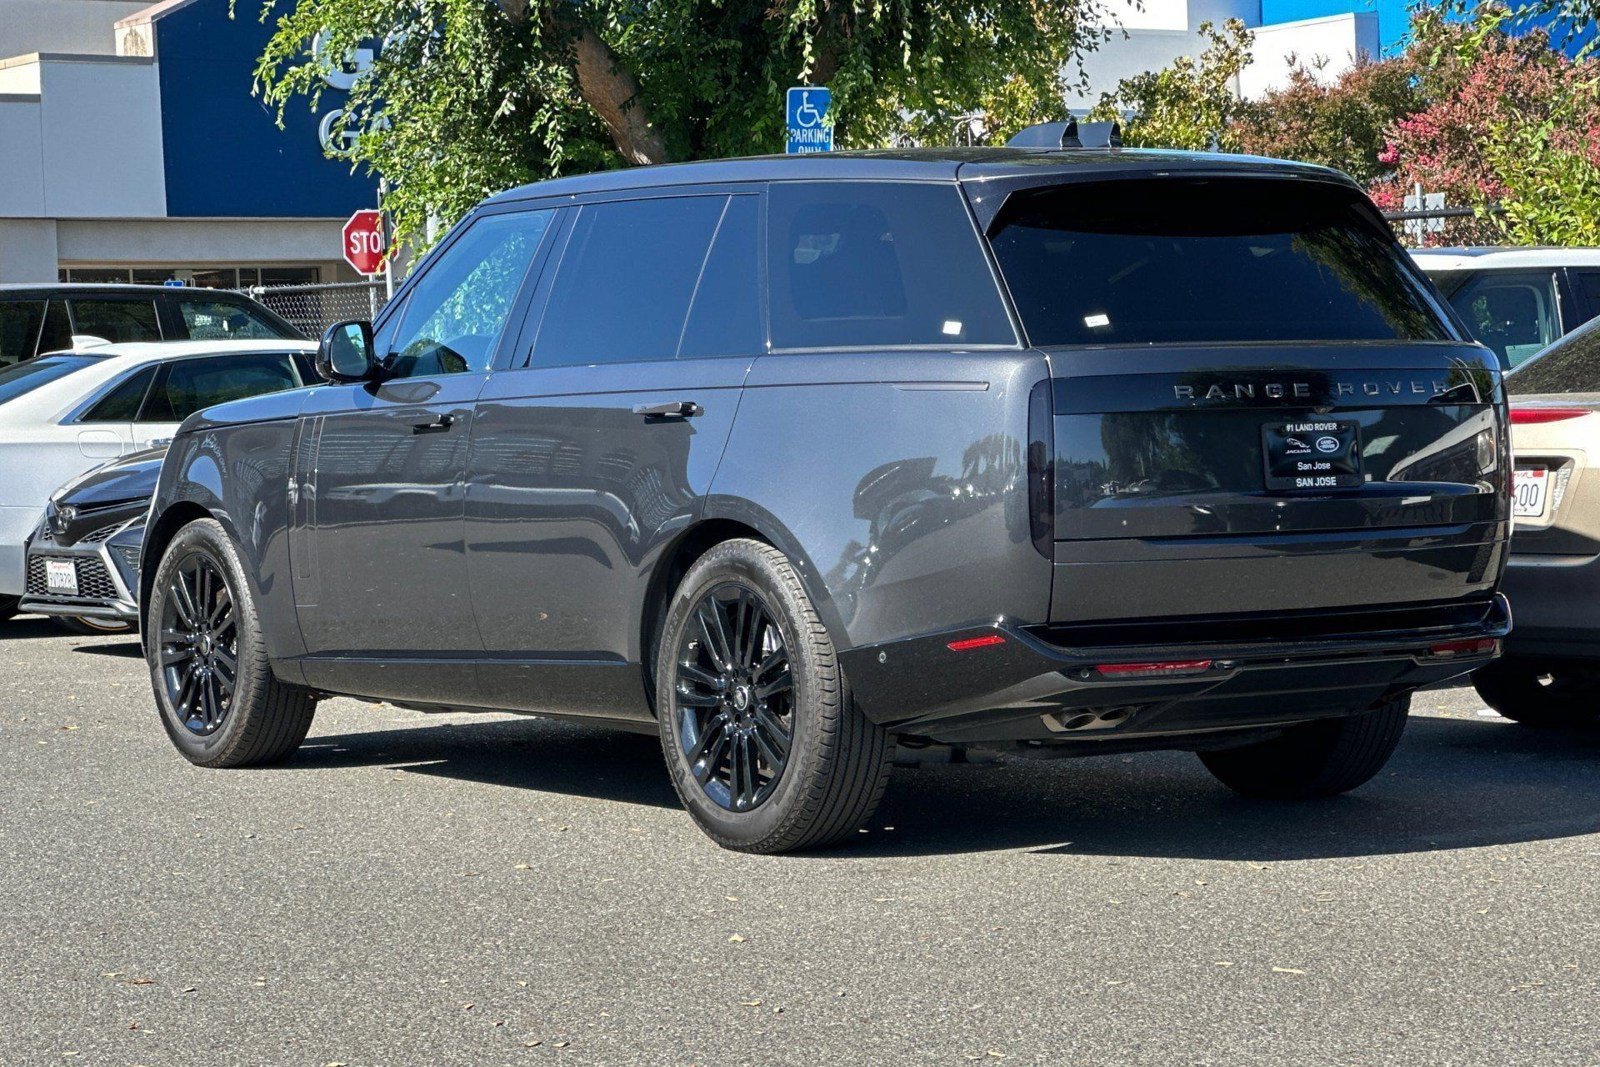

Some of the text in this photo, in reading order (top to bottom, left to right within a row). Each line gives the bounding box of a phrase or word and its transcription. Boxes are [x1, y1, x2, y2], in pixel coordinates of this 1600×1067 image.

[790, 128, 829, 143] PARKING
[350, 231, 386, 254] STO
[1174, 380, 1448, 399] RANGE ROVER
[1286, 422, 1337, 431] #1 LAND ROVER
[1297, 461, 1331, 470] San Jose
[1296, 476, 1337, 487] SAN JOSE
[1513, 483, 1539, 507] 00
